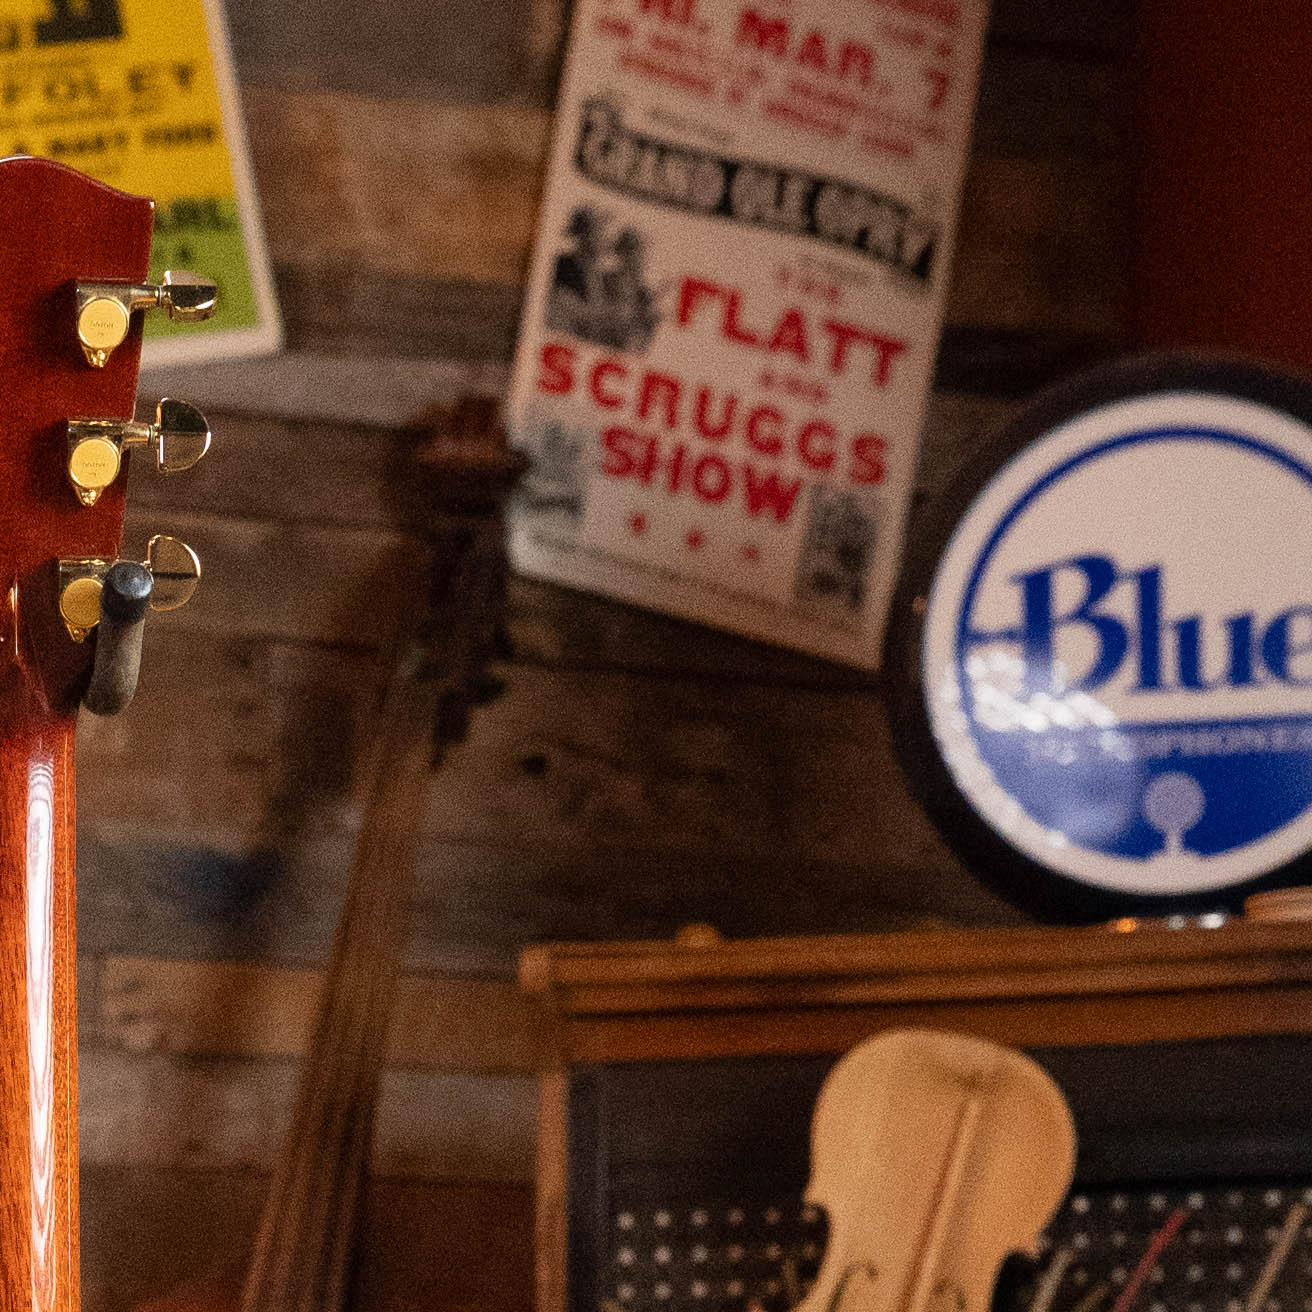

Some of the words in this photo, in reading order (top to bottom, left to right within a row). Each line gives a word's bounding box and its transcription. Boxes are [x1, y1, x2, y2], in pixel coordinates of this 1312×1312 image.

[676, 275, 908, 387] FLATT
[536, 342, 888, 488] SCRUGGS
[600, 425, 803, 525] SHOW
[1008, 553, 1312, 693] Blue
